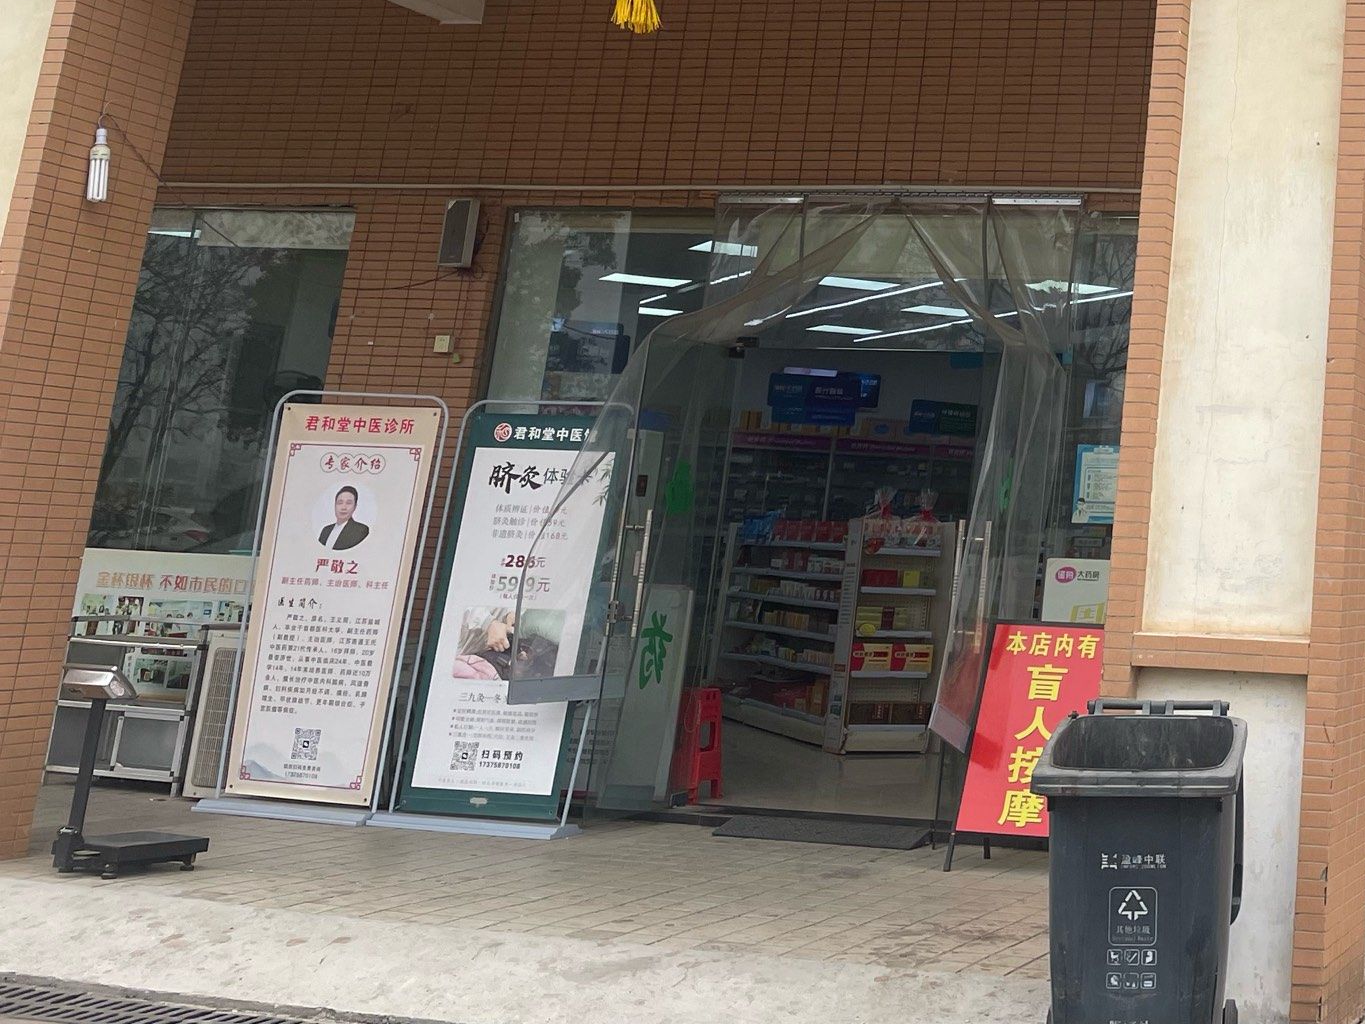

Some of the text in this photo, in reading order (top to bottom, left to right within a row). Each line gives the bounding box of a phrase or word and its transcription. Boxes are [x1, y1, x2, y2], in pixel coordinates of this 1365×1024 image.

[305, 415, 415, 434] 君和堂中医诊所
[324, 455, 382, 471] 专家介绍
[315, 558, 360, 574] 严敬之
[160, 574, 257, 596] 不如市民的口
[1006, 630, 1100, 659] 本店内有
[481, 749, 524, 762] 扫码预约
